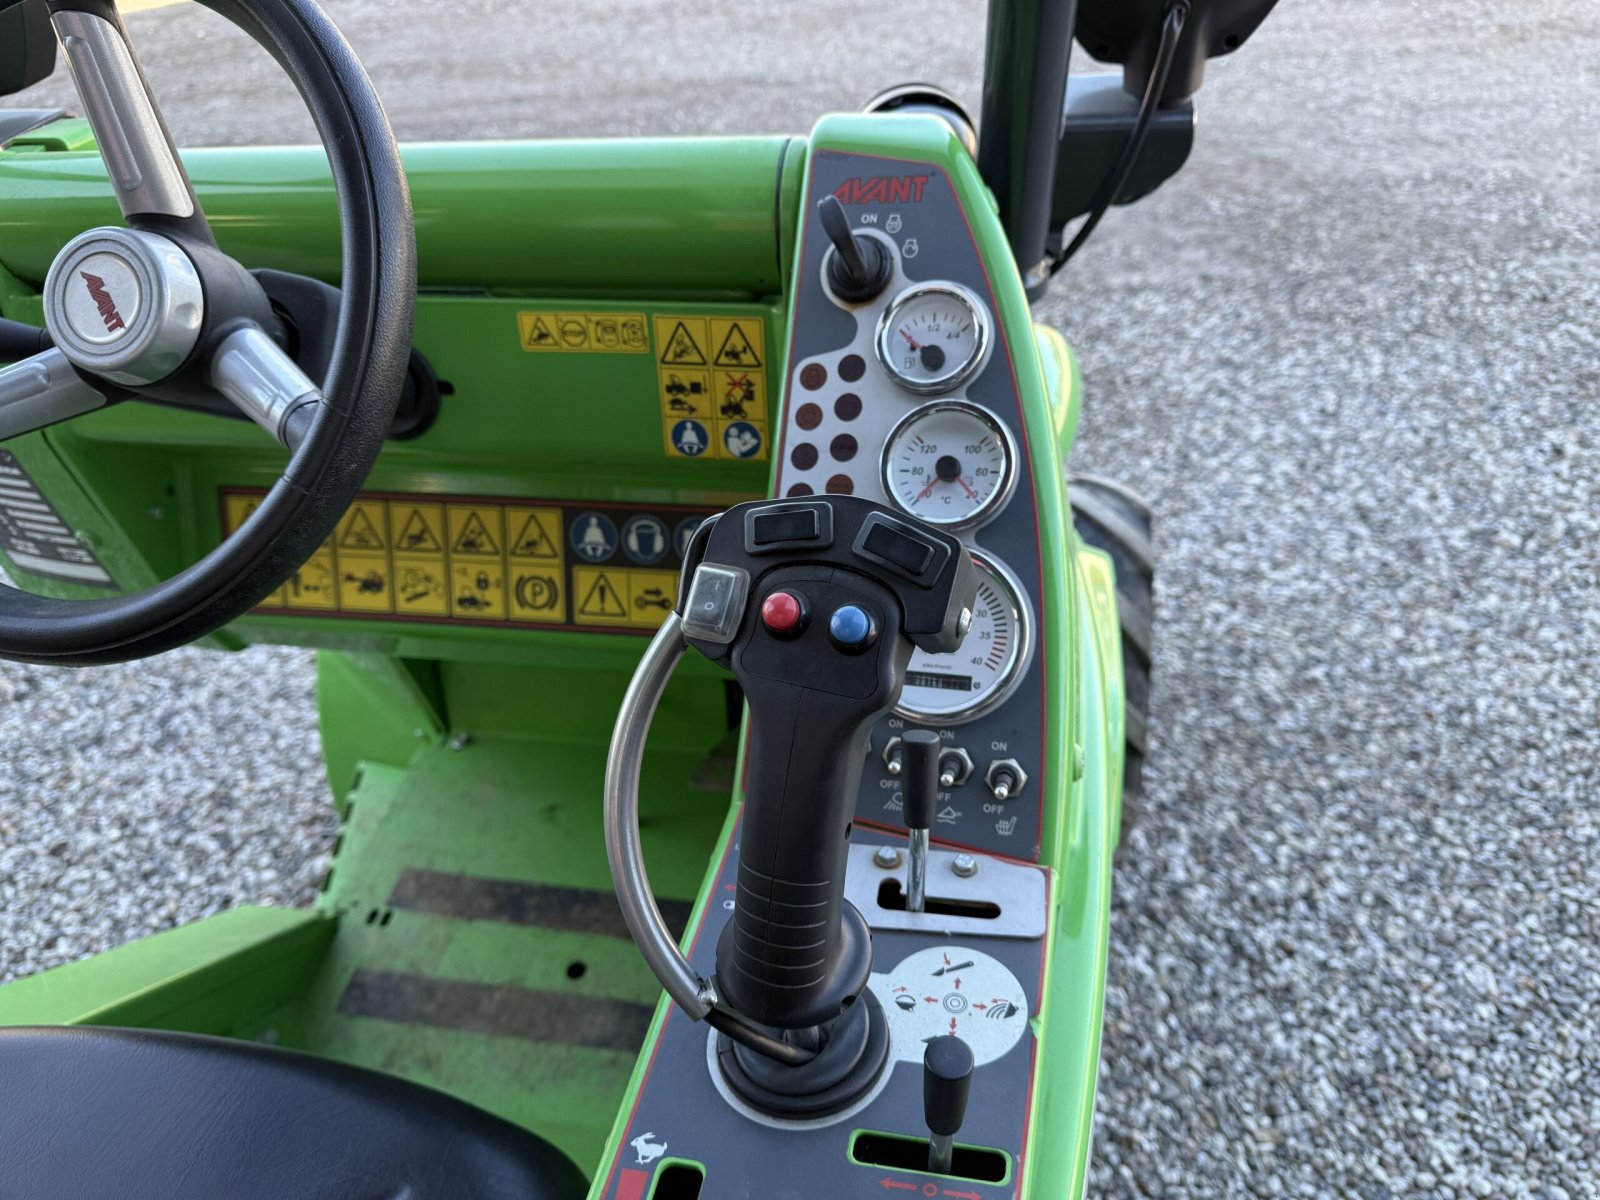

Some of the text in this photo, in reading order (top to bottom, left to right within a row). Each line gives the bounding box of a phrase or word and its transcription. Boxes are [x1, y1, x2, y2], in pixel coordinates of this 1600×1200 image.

[830, 174, 928, 205] AVANT
[861, 213, 878, 224] ON
[80, 270, 126, 333] AVANT
[927, 324, 941, 332] 1/2
[946, 332, 960, 340] 4/4
[920, 445, 937, 454] 120
[964, 445, 982, 454] 100
[911, 466, 924, 476] 80
[975, 467, 989, 477] 60
[975, 609, 988, 618] 30
[978, 631, 991, 640] 35
[922, 662, 952, 670] electronic
[970, 656, 983, 666] 40
[888, 719, 904, 729] ON
[939, 730, 955, 740] ON
[990, 741, 1008, 752] ON
[879, 779, 900, 790] OFF
[936, 792, 952, 802] FF
[982, 803, 1005, 816] OFF
